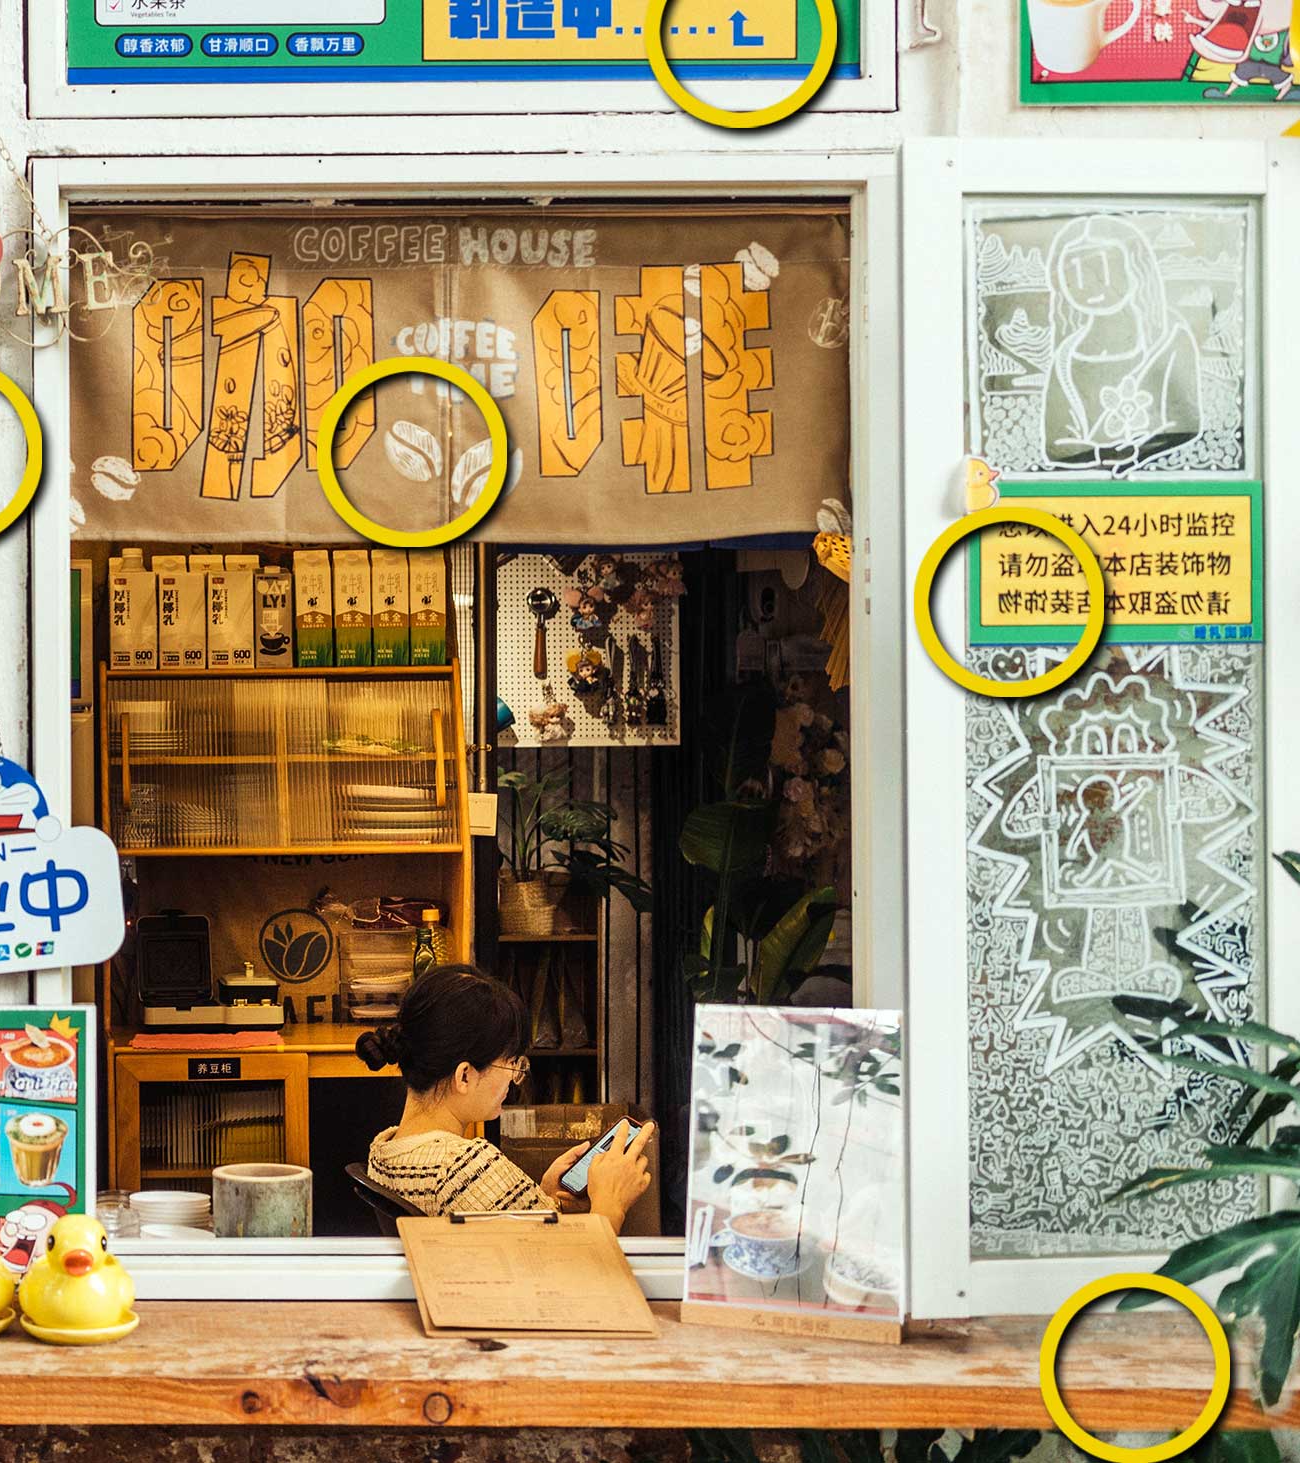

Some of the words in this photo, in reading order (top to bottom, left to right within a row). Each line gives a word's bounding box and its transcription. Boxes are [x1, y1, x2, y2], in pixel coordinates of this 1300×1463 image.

[123, 38, 186, 53] 醇香浓郁
[207, 38, 270, 53] 甘滑顺口
[294, 37, 357, 52] 香飘万里
[293, 224, 448, 264] COFFEE
[458, 225, 597, 268] HOUSE
[998, 552, 1232, 578] 请勿盗本店装饰物
[262, 594, 287, 609] LY!
[135, 651, 153, 660] 600
[184, 650, 202, 660] 600
[233, 649, 251, 659] 600
[197, 1062, 233, 1075] 养豆柜
